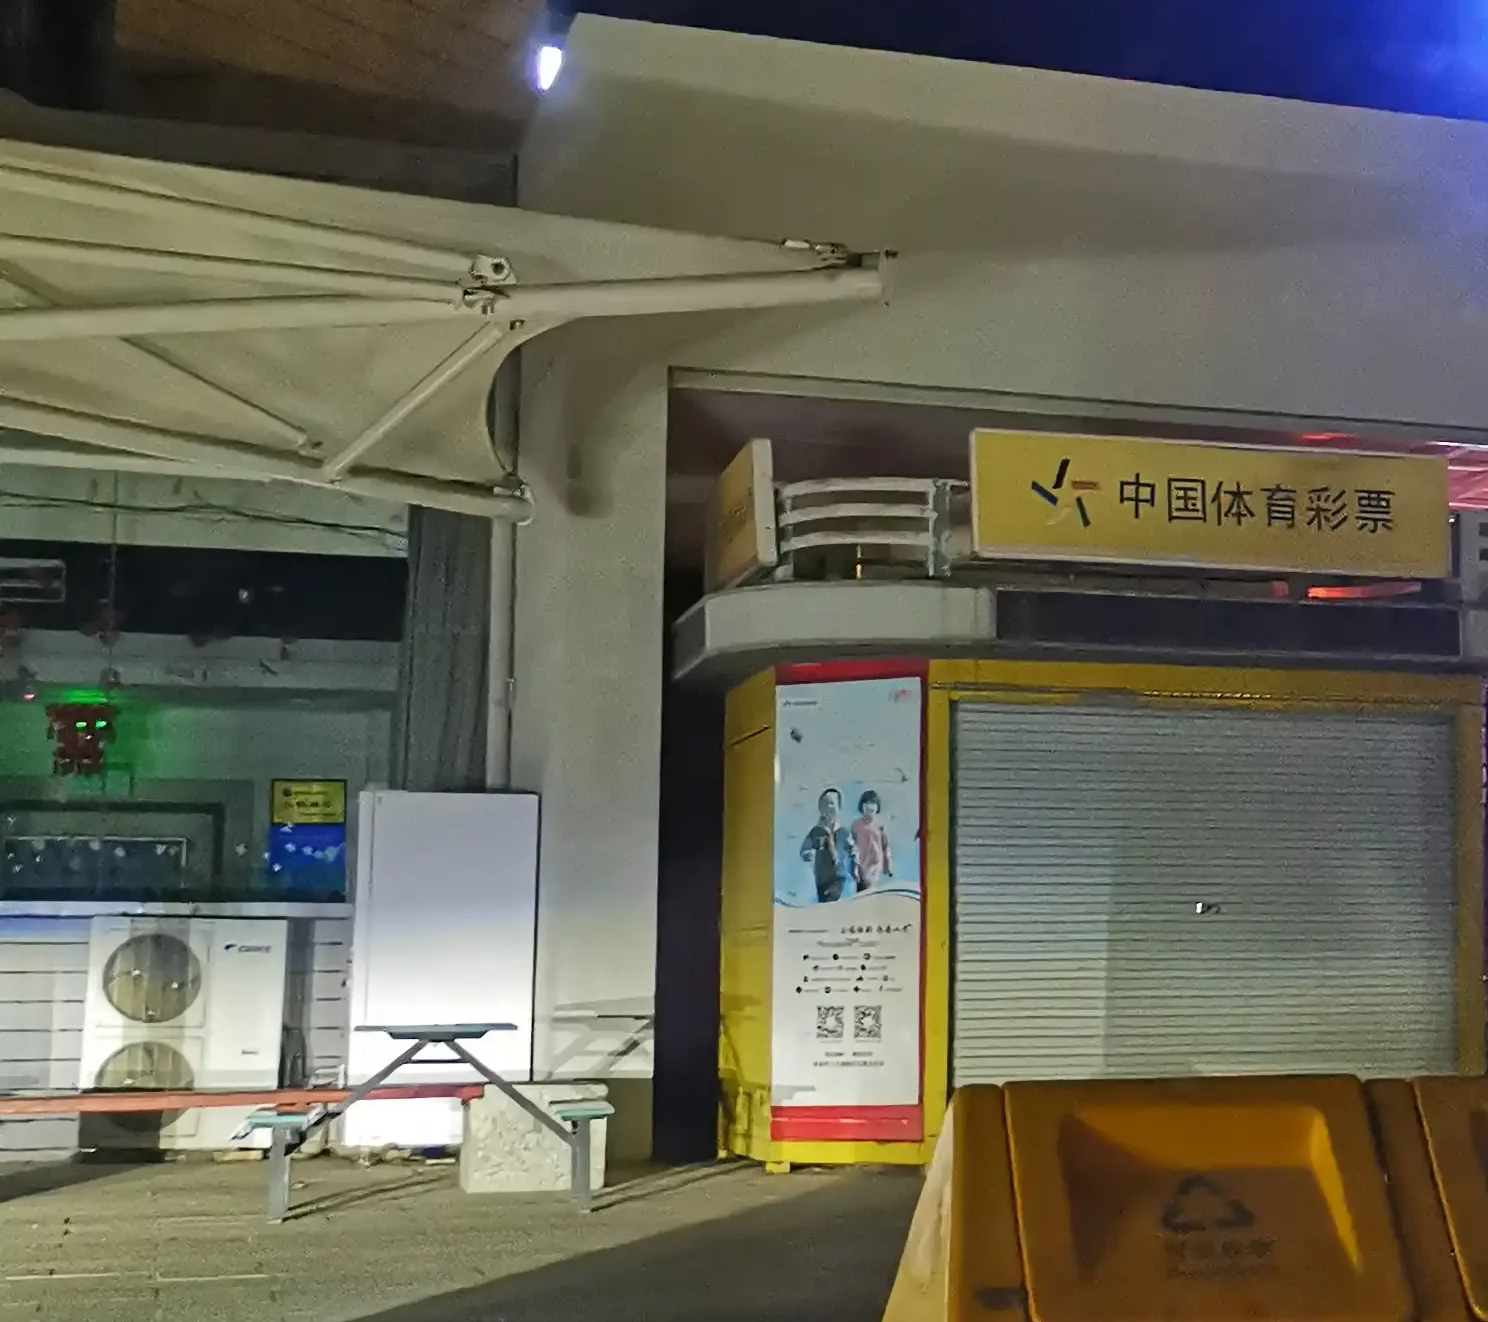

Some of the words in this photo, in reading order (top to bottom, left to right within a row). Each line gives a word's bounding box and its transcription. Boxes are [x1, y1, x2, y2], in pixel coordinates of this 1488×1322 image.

[1118, 472, 1398, 534] 中国体育彩票
